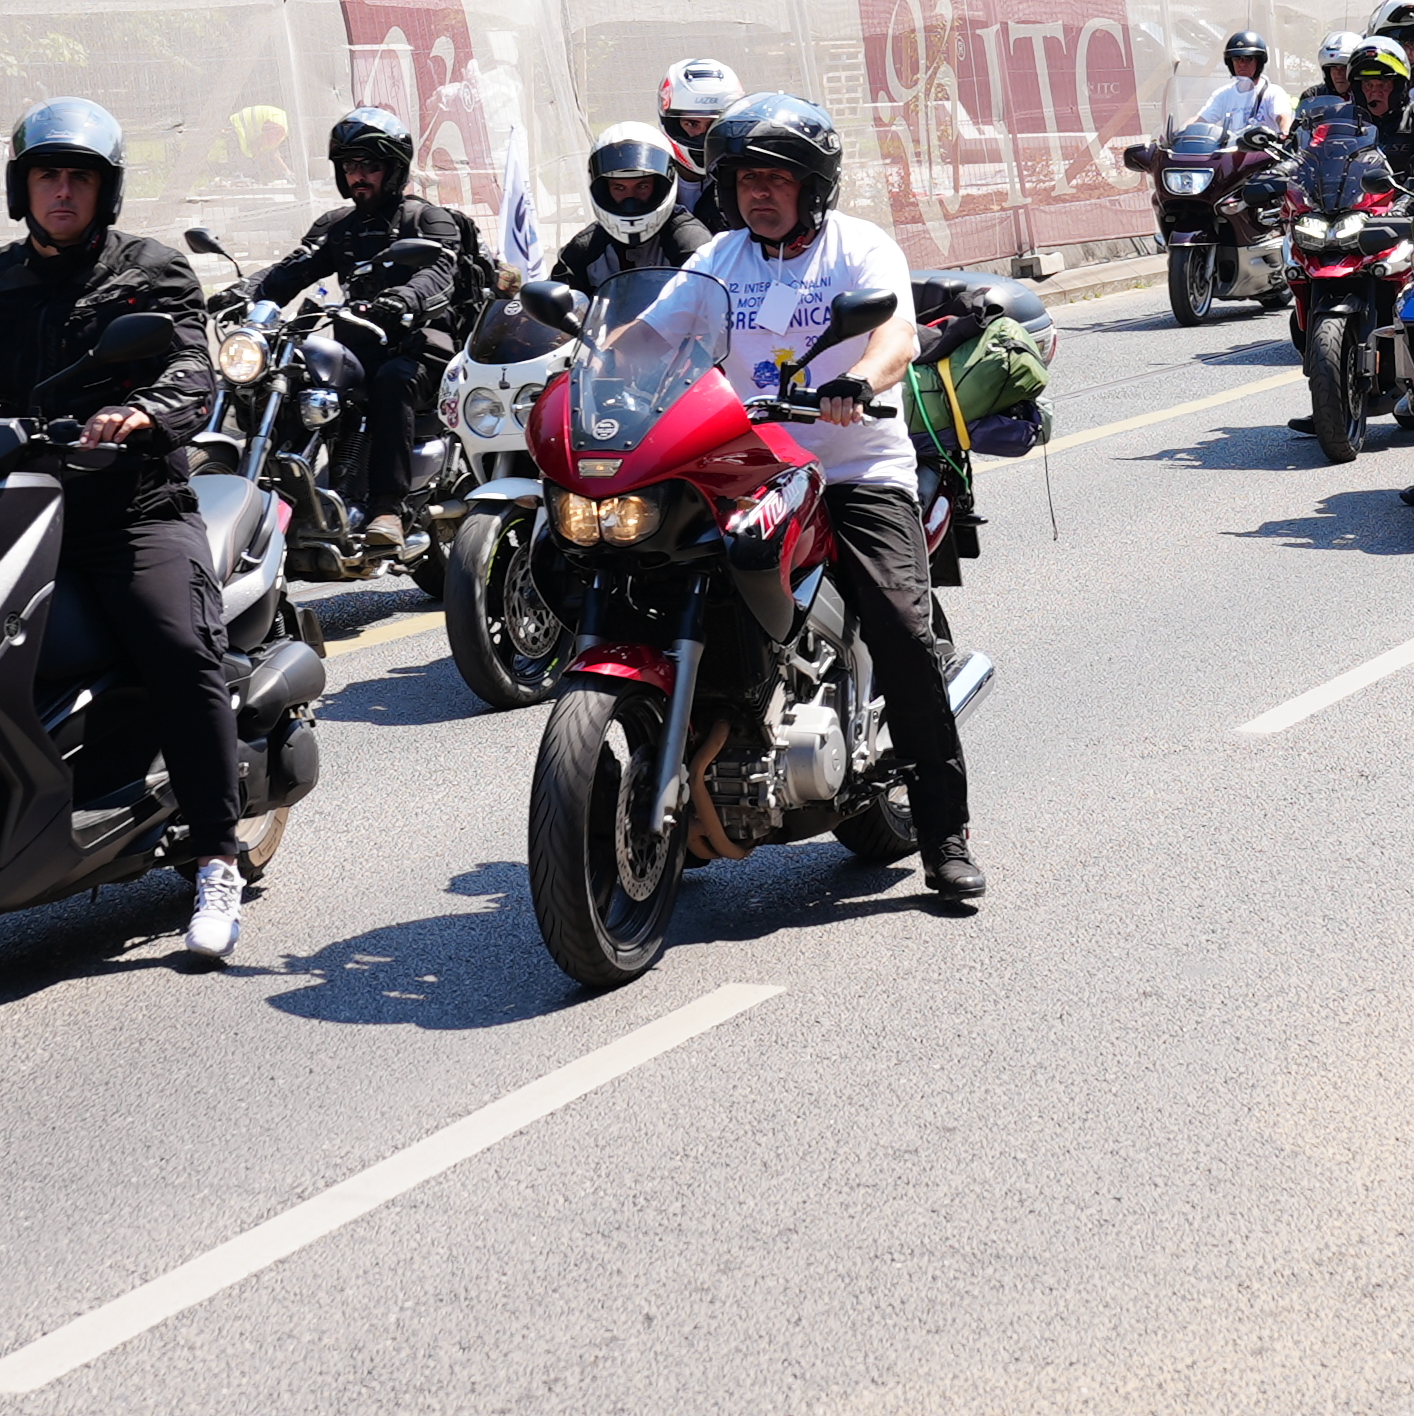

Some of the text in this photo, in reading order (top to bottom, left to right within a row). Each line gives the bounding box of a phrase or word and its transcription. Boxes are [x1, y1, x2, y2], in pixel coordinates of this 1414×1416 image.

[1097, 82, 1120, 94] ITC
[694, 96, 719, 105] LAZER
[976, 17, 1142, 207] ITC
[744, 276, 831, 294] INTERONALNI
[737, 292, 823, 309] MOTTON
[725, 305, 832, 331] SRENICA
